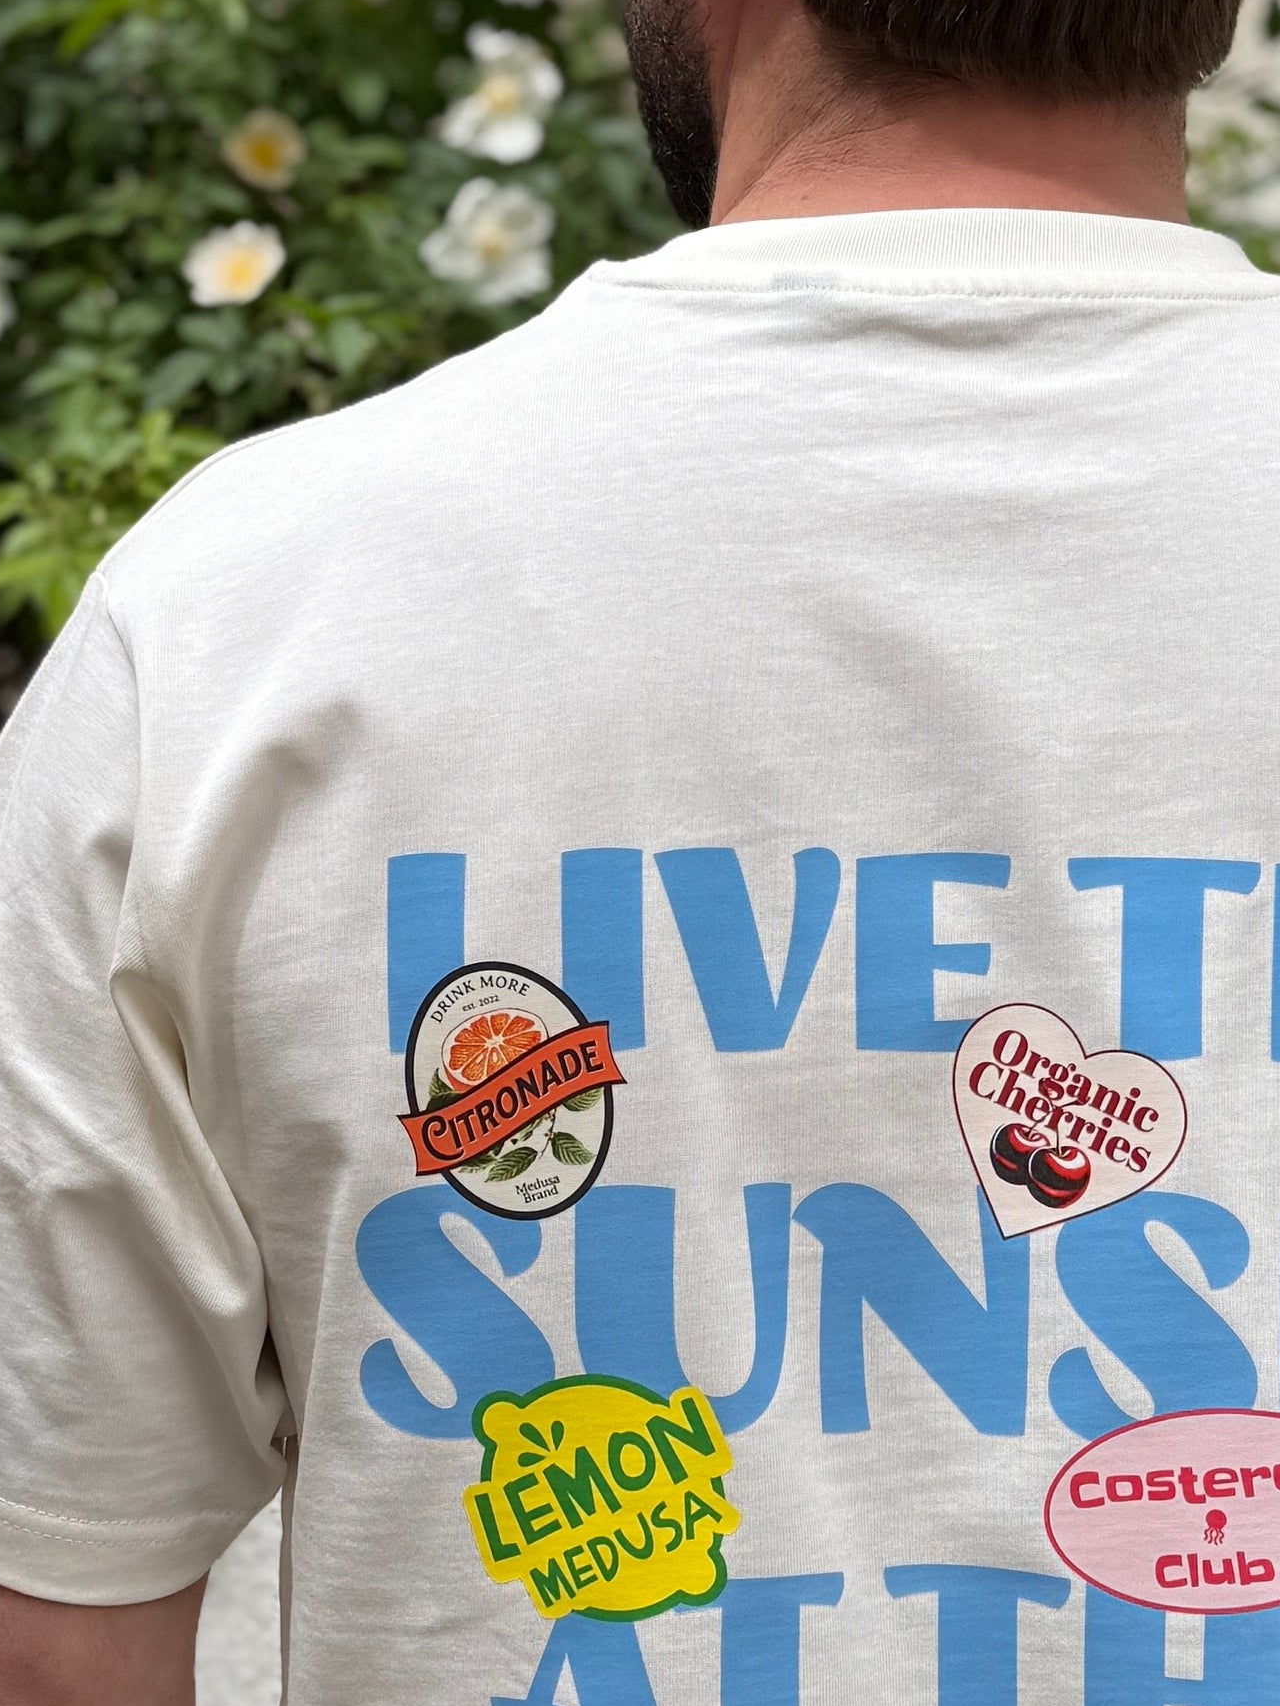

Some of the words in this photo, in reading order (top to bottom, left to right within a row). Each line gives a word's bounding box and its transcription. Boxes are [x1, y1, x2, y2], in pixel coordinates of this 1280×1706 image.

[385, 847, 1010, 1053] LIVE
[431, 980, 476, 1023] DRINK
[480, 975, 530, 996] MORE
[479, 995, 499, 1007] 2022
[421, 1039, 604, 1161] CITRONADE
[969, 1061, 1152, 1173] Cherries
[992, 1029, 1159, 1133] Organic
[515, 1175, 561, 1195] Medusa
[523, 1184, 559, 1204] Brand
[474, 1397, 717, 1563] LEMON
[528, 1490, 724, 1609] MEDUSA
[1155, 1551, 1276, 1589] Club
